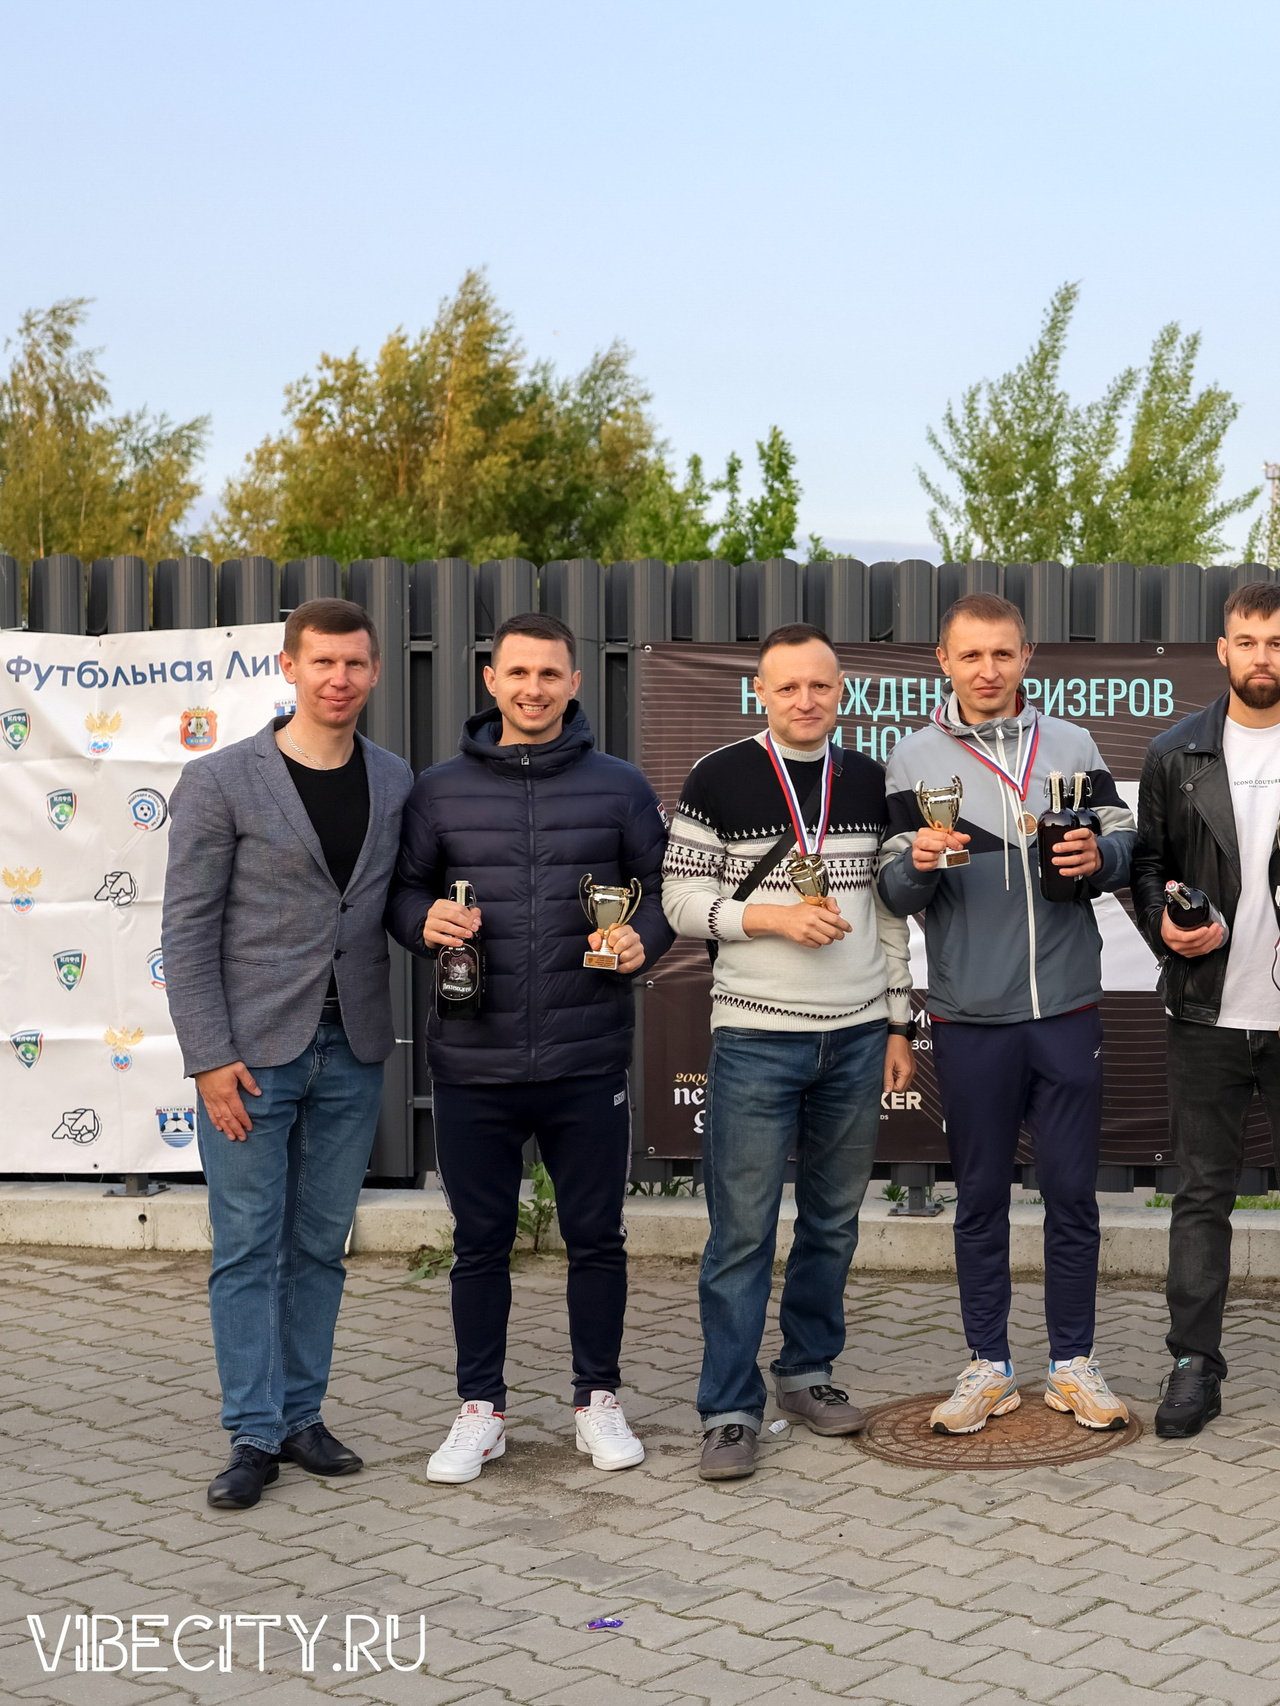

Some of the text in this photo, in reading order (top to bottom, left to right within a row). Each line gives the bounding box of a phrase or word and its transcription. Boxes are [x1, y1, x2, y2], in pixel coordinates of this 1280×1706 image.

[6, 650, 285, 691] Футбольная Ли
[1023, 678, 1175, 717] РИЗЕРОВ
